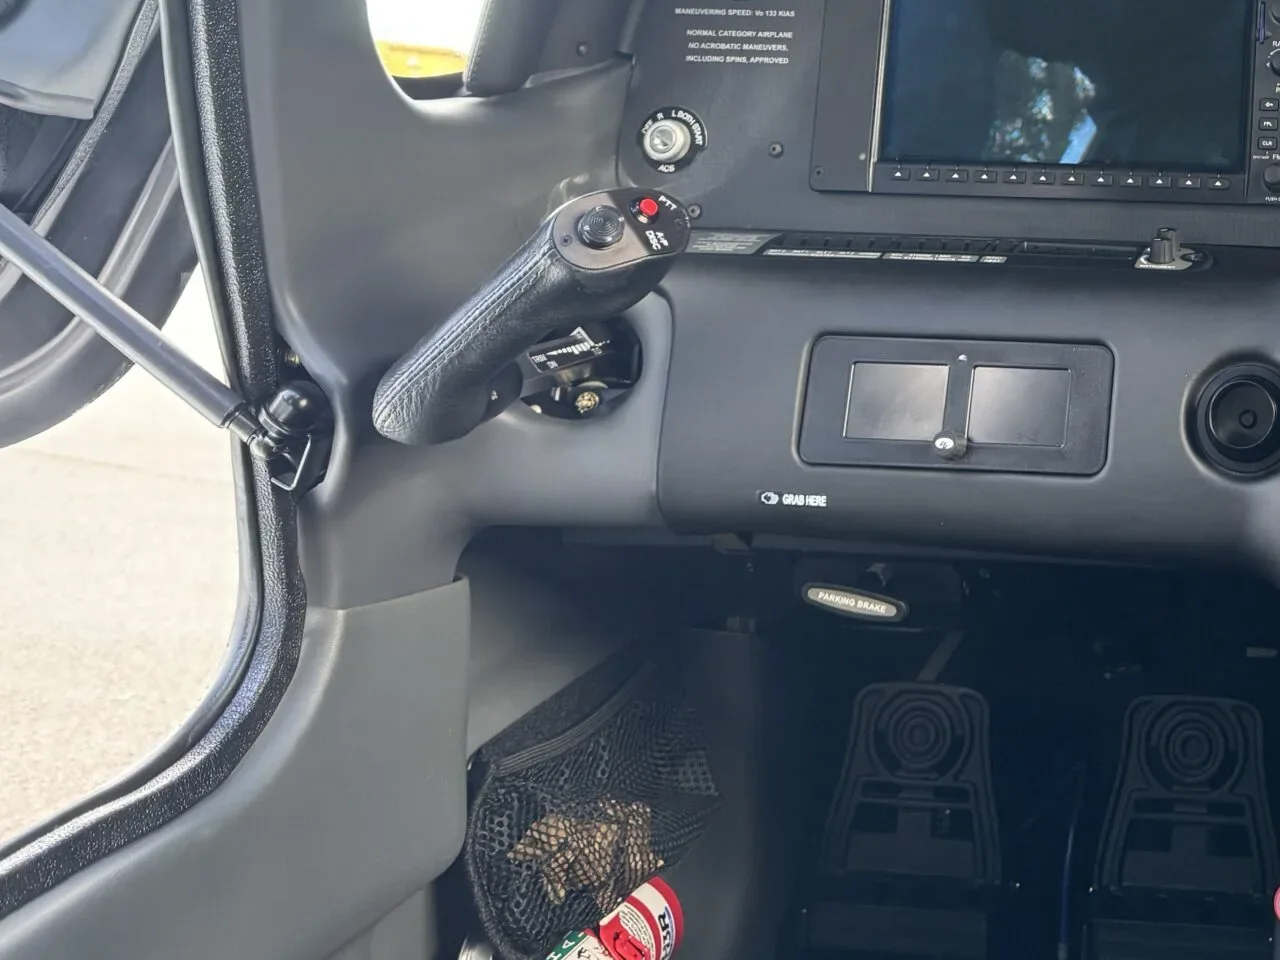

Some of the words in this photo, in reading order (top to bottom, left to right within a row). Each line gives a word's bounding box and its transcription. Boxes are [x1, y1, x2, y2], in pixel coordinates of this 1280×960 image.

[686, 55, 724, 63] INCLUDING
[657, 112, 664, 120] R
[677, 110, 695, 125] BOTH
[692, 122, 703, 145] START
[658, 164, 676, 172] ACS
[658, 195, 678, 211] PTT
[782, 494, 804, 506] GRAB
[806, 495, 827, 507] HERE
[817, 592, 856, 606] PARKING
[857, 601, 886, 613] BRAKE
